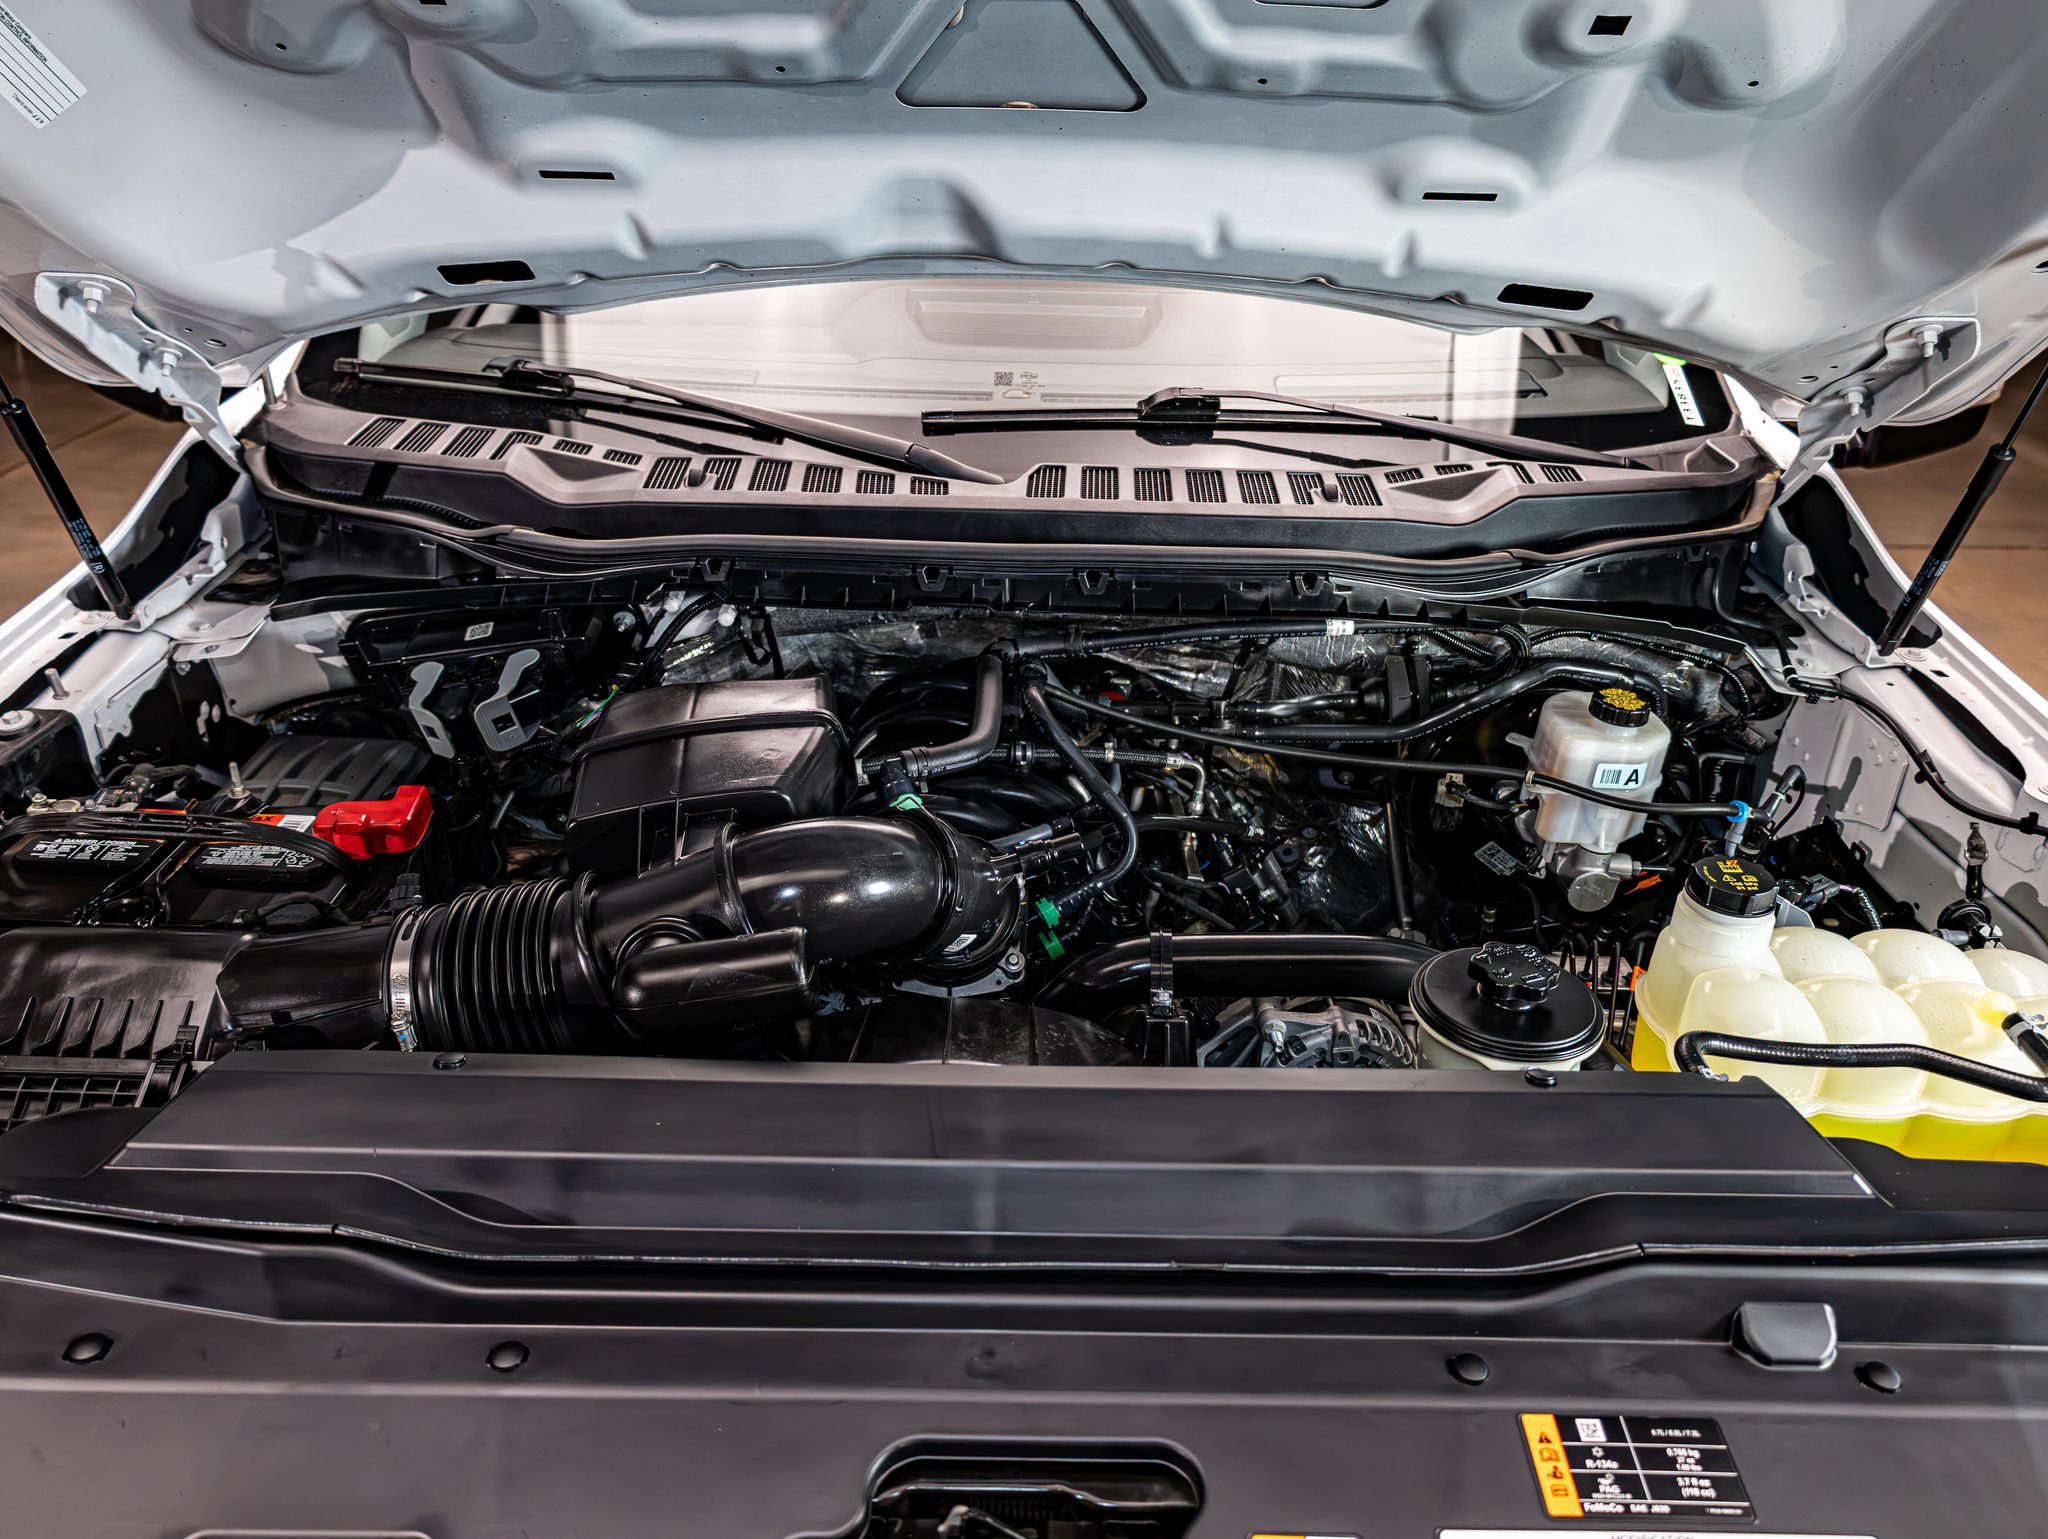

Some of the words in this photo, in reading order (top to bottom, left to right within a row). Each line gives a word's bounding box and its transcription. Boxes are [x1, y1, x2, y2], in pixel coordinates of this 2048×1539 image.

[22, 36, 48, 62] INFORMATION
[1624, 769, 1639, 785] A
[1585, 1459, 1619, 1469] R-134a
